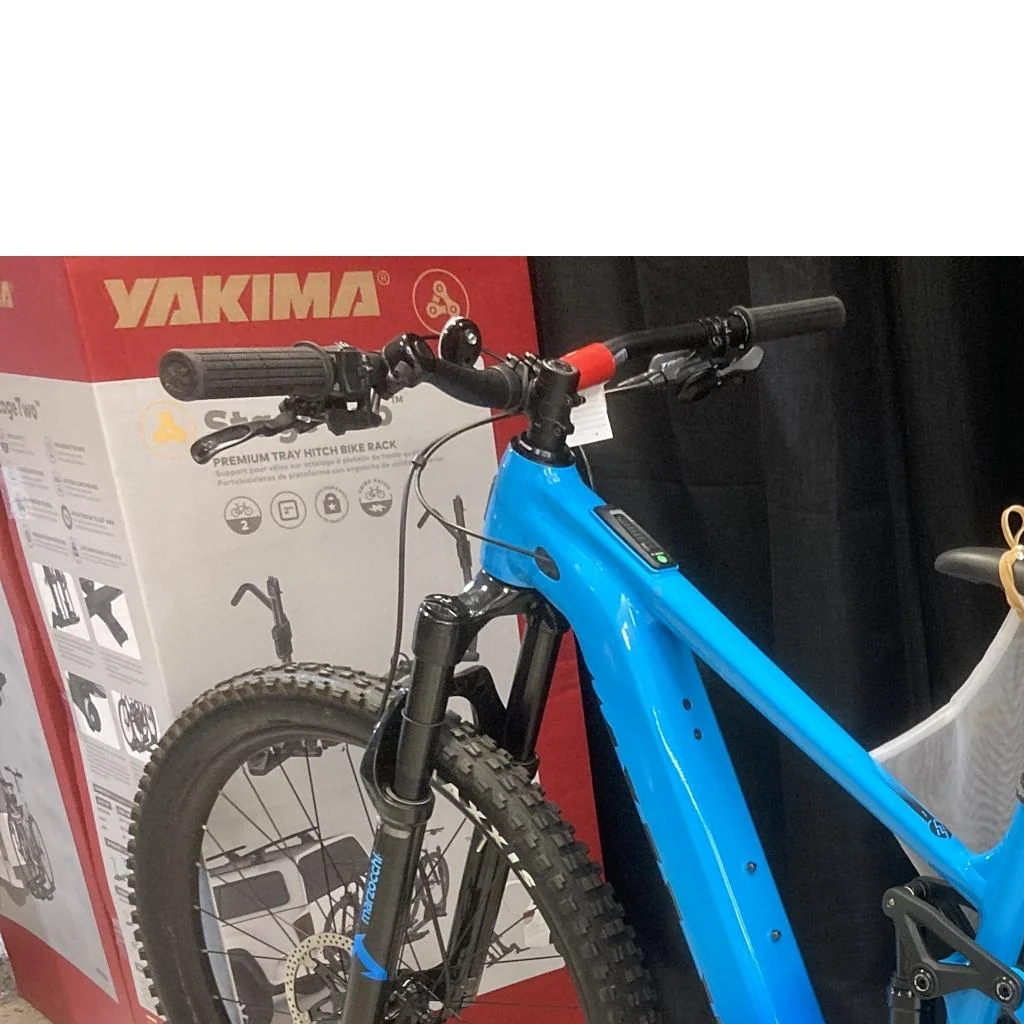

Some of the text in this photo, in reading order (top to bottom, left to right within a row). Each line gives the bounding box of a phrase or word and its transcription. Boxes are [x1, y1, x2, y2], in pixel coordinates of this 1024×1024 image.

[213, 440, 397, 468] PREMIUM TRAY HITCH BIKE RACK
[240, 520, 249, 531] 2
[361, 850, 384, 925] marzocchi
